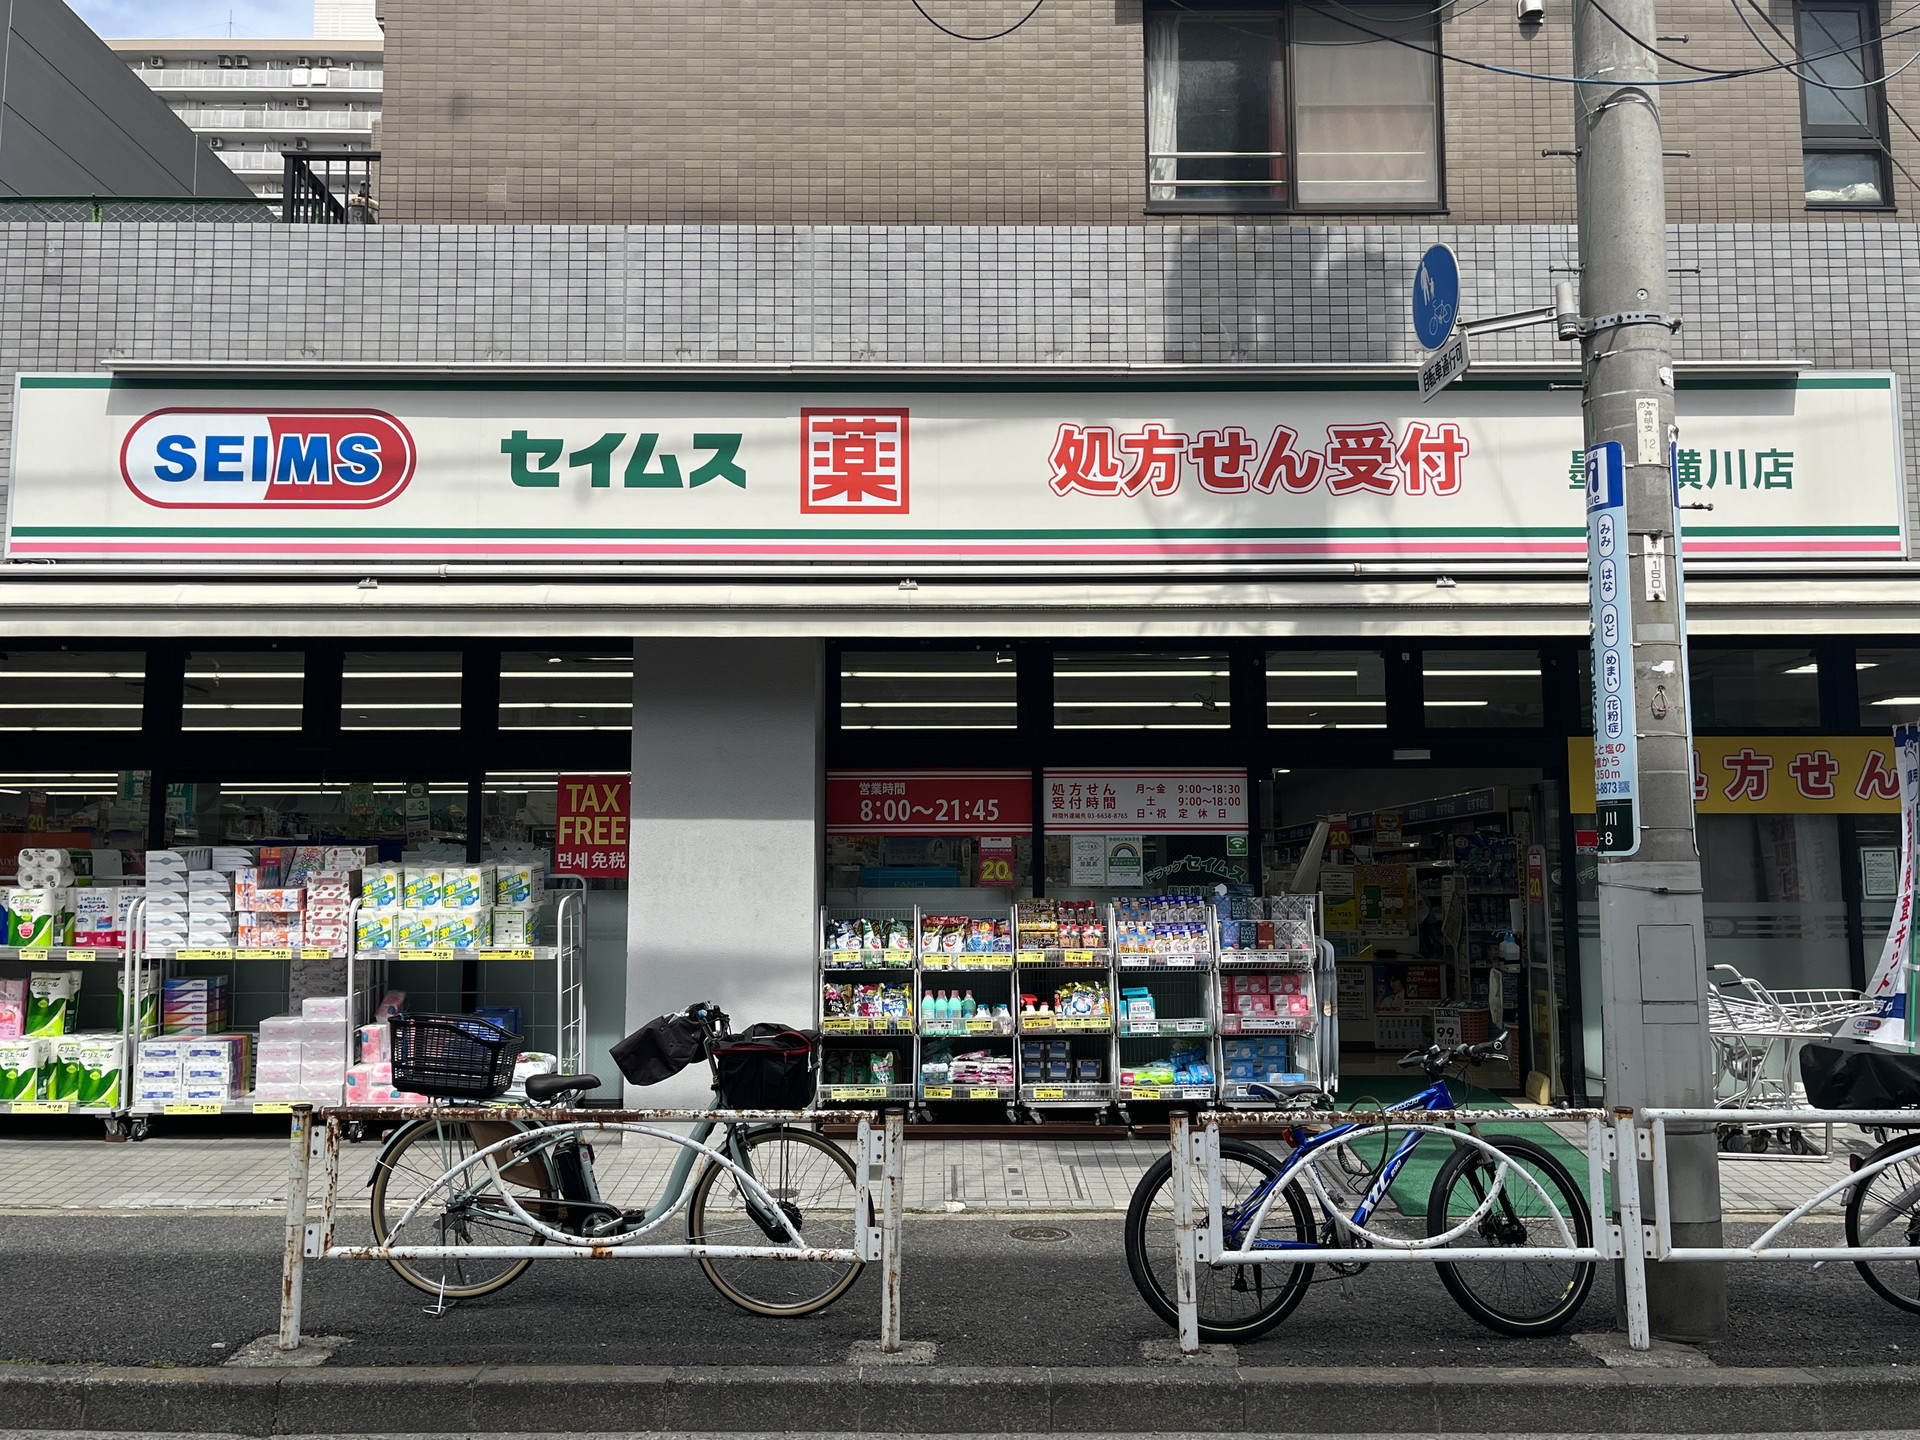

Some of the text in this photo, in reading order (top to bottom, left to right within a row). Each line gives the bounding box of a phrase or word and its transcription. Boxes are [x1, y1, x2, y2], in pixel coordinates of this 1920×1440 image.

[1423, 341, 1464, 392] 自転車通行可
[152, 433, 384, 487] SEIMS
[500, 429, 747, 490] セイムス
[811, 417, 899, 504] 薬
[1048, 423, 1470, 497] 処方せん受付
[1600, 523, 1611, 547] みみ
[1602, 568, 1613, 592] はな
[1603, 613, 1614, 637] のど
[1605, 654, 1618, 687] めまい
[1607, 699, 1619, 733] 花粉症
[565, 784, 621, 813] TAX
[859, 782, 906, 795] 営業時間
[1052, 783, 1116, 796] 処方せん
[1052, 797, 1116, 810] 受付時間
[558, 816, 627, 845] FREE
[558, 851, 626, 869] 면세 免税
[1436, 1027, 1455, 1038] 99
